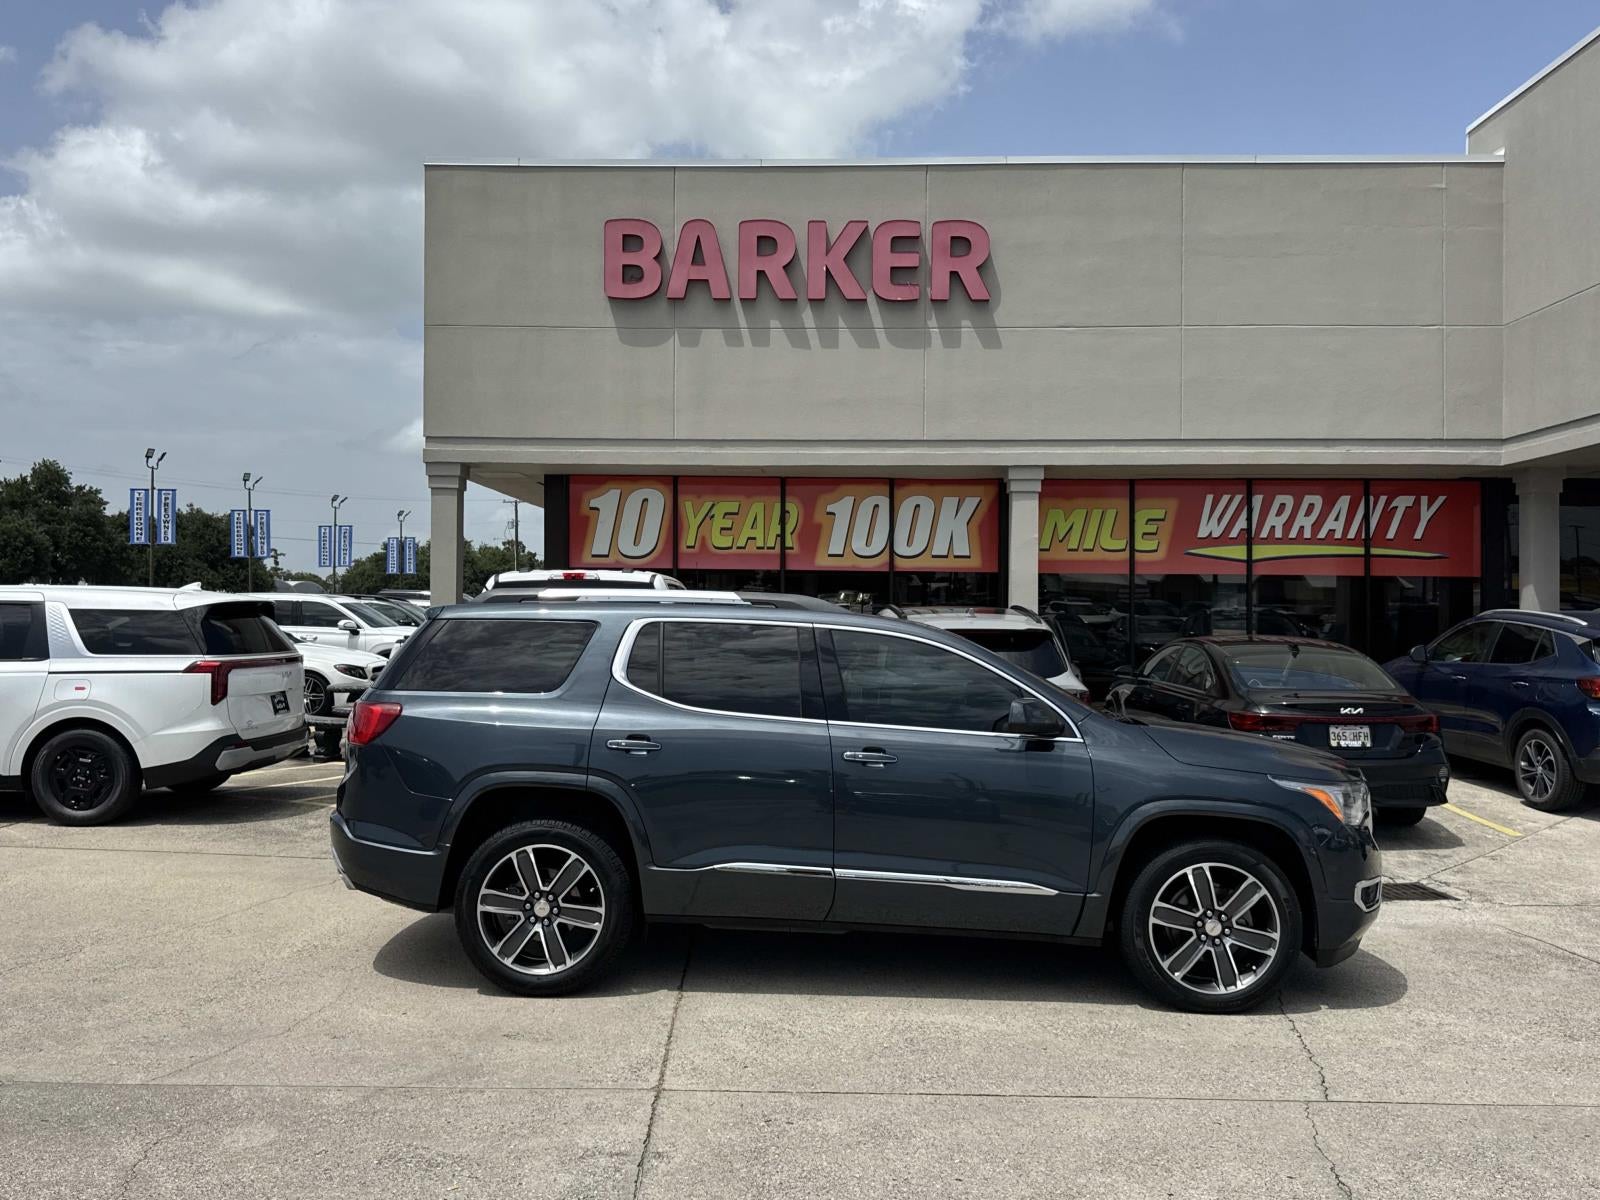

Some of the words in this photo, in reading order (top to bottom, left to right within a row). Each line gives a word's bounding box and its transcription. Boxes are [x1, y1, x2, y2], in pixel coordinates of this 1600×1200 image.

[604, 219, 991, 300] BARKER
[588, 488, 667, 558] 10
[684, 501, 799, 550] YEAR
[826, 495, 981, 558] 100K
[1039, 508, 1167, 553] MILE
[1197, 494, 1447, 540] WARRANTY
[1331, 731, 1347, 741] 365
